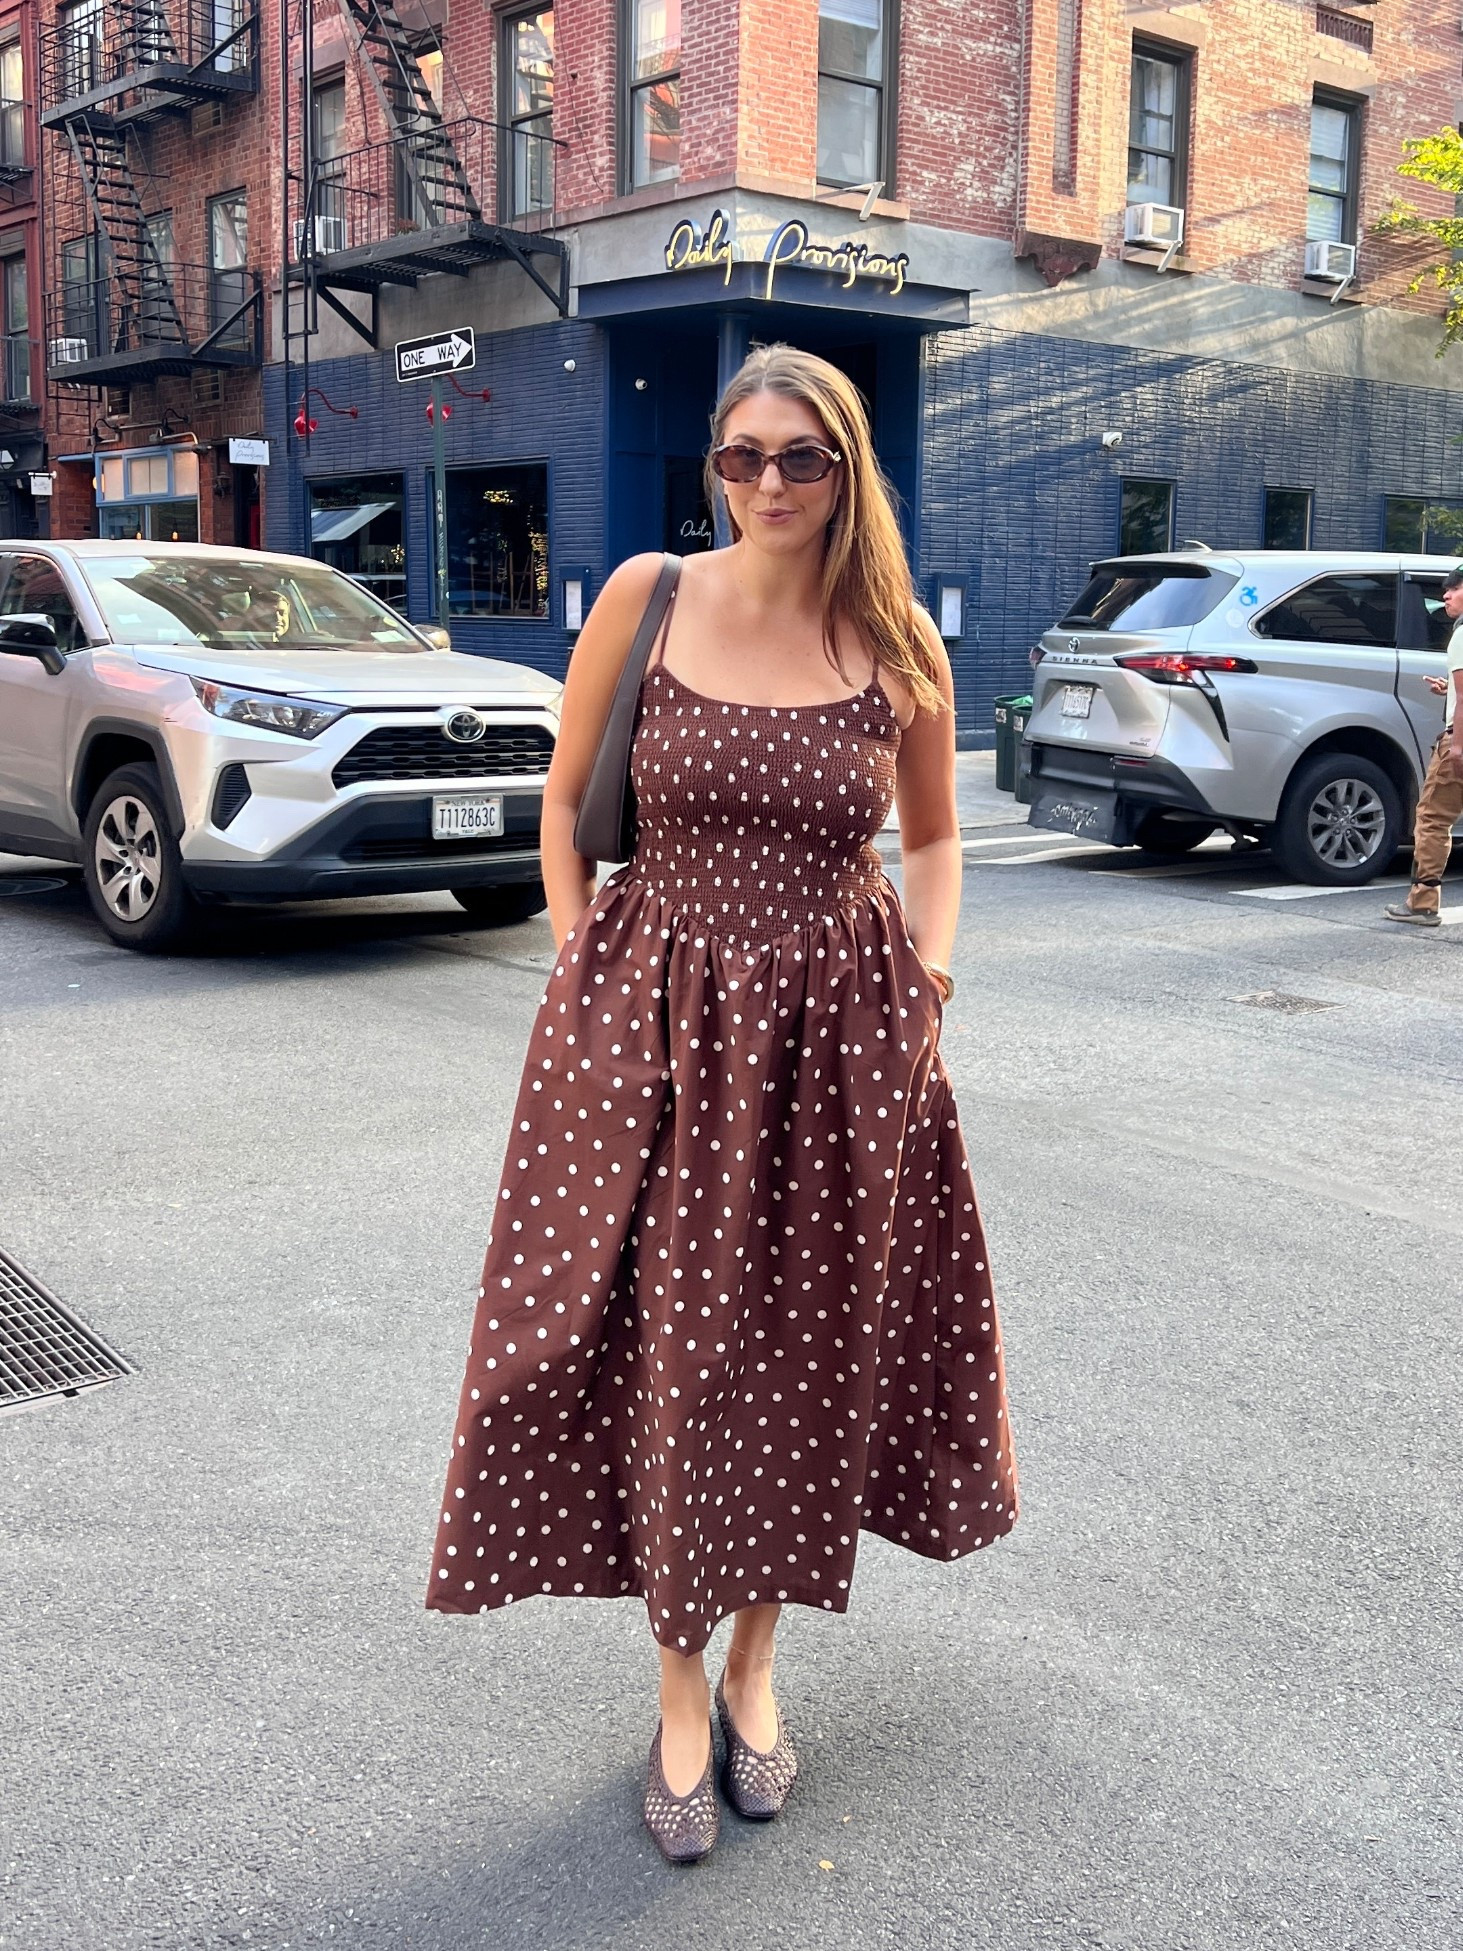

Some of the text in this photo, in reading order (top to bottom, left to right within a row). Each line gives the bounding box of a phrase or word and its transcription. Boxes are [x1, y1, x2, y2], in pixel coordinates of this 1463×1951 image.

[665, 214, 909, 300] Daily Provisions
[403, 342, 462, 368] ONE WAY
[680, 519, 712, 547] Daily
[439, 806, 496, 829] T112863C
